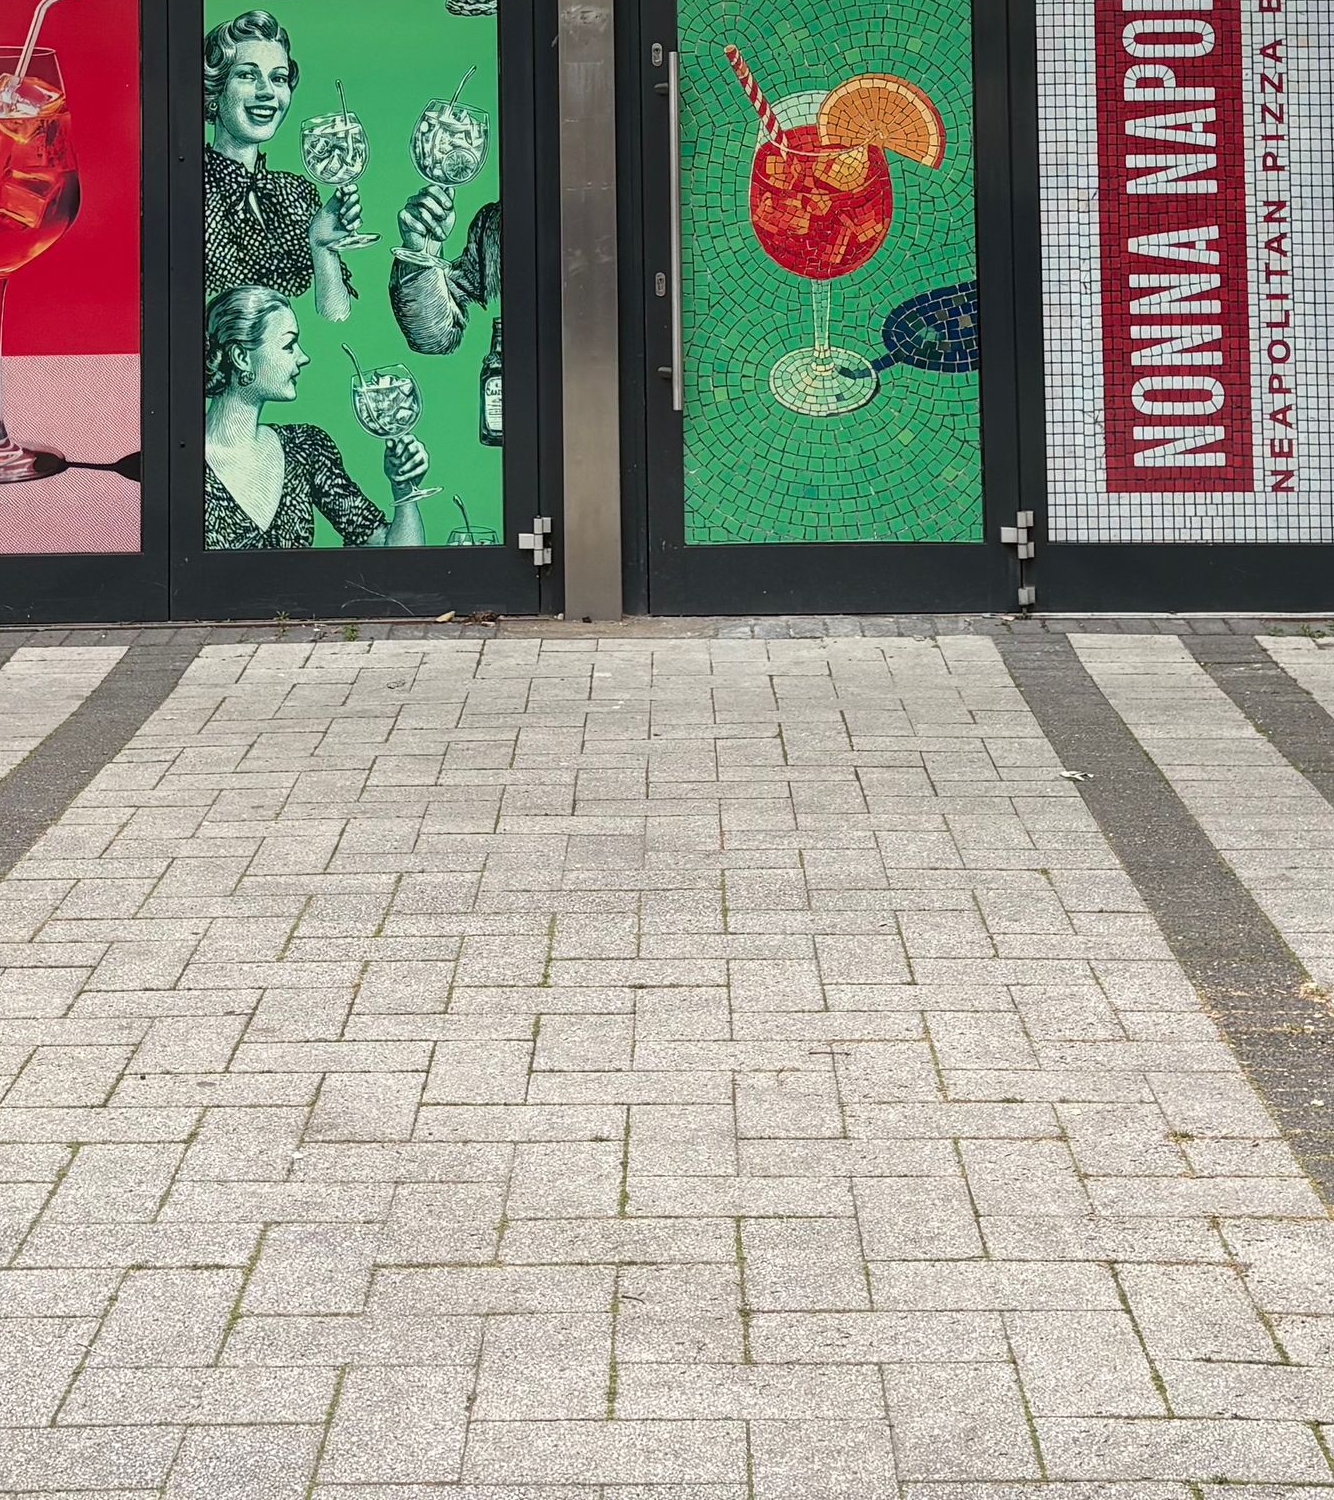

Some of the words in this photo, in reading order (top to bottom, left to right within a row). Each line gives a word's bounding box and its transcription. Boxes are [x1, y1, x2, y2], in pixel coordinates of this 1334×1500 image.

[1259, 38, 1287, 173] PIZZA
[1127, 224, 1227, 468] NONNA
[1262, 199, 1296, 493] NEAPOLITAN
